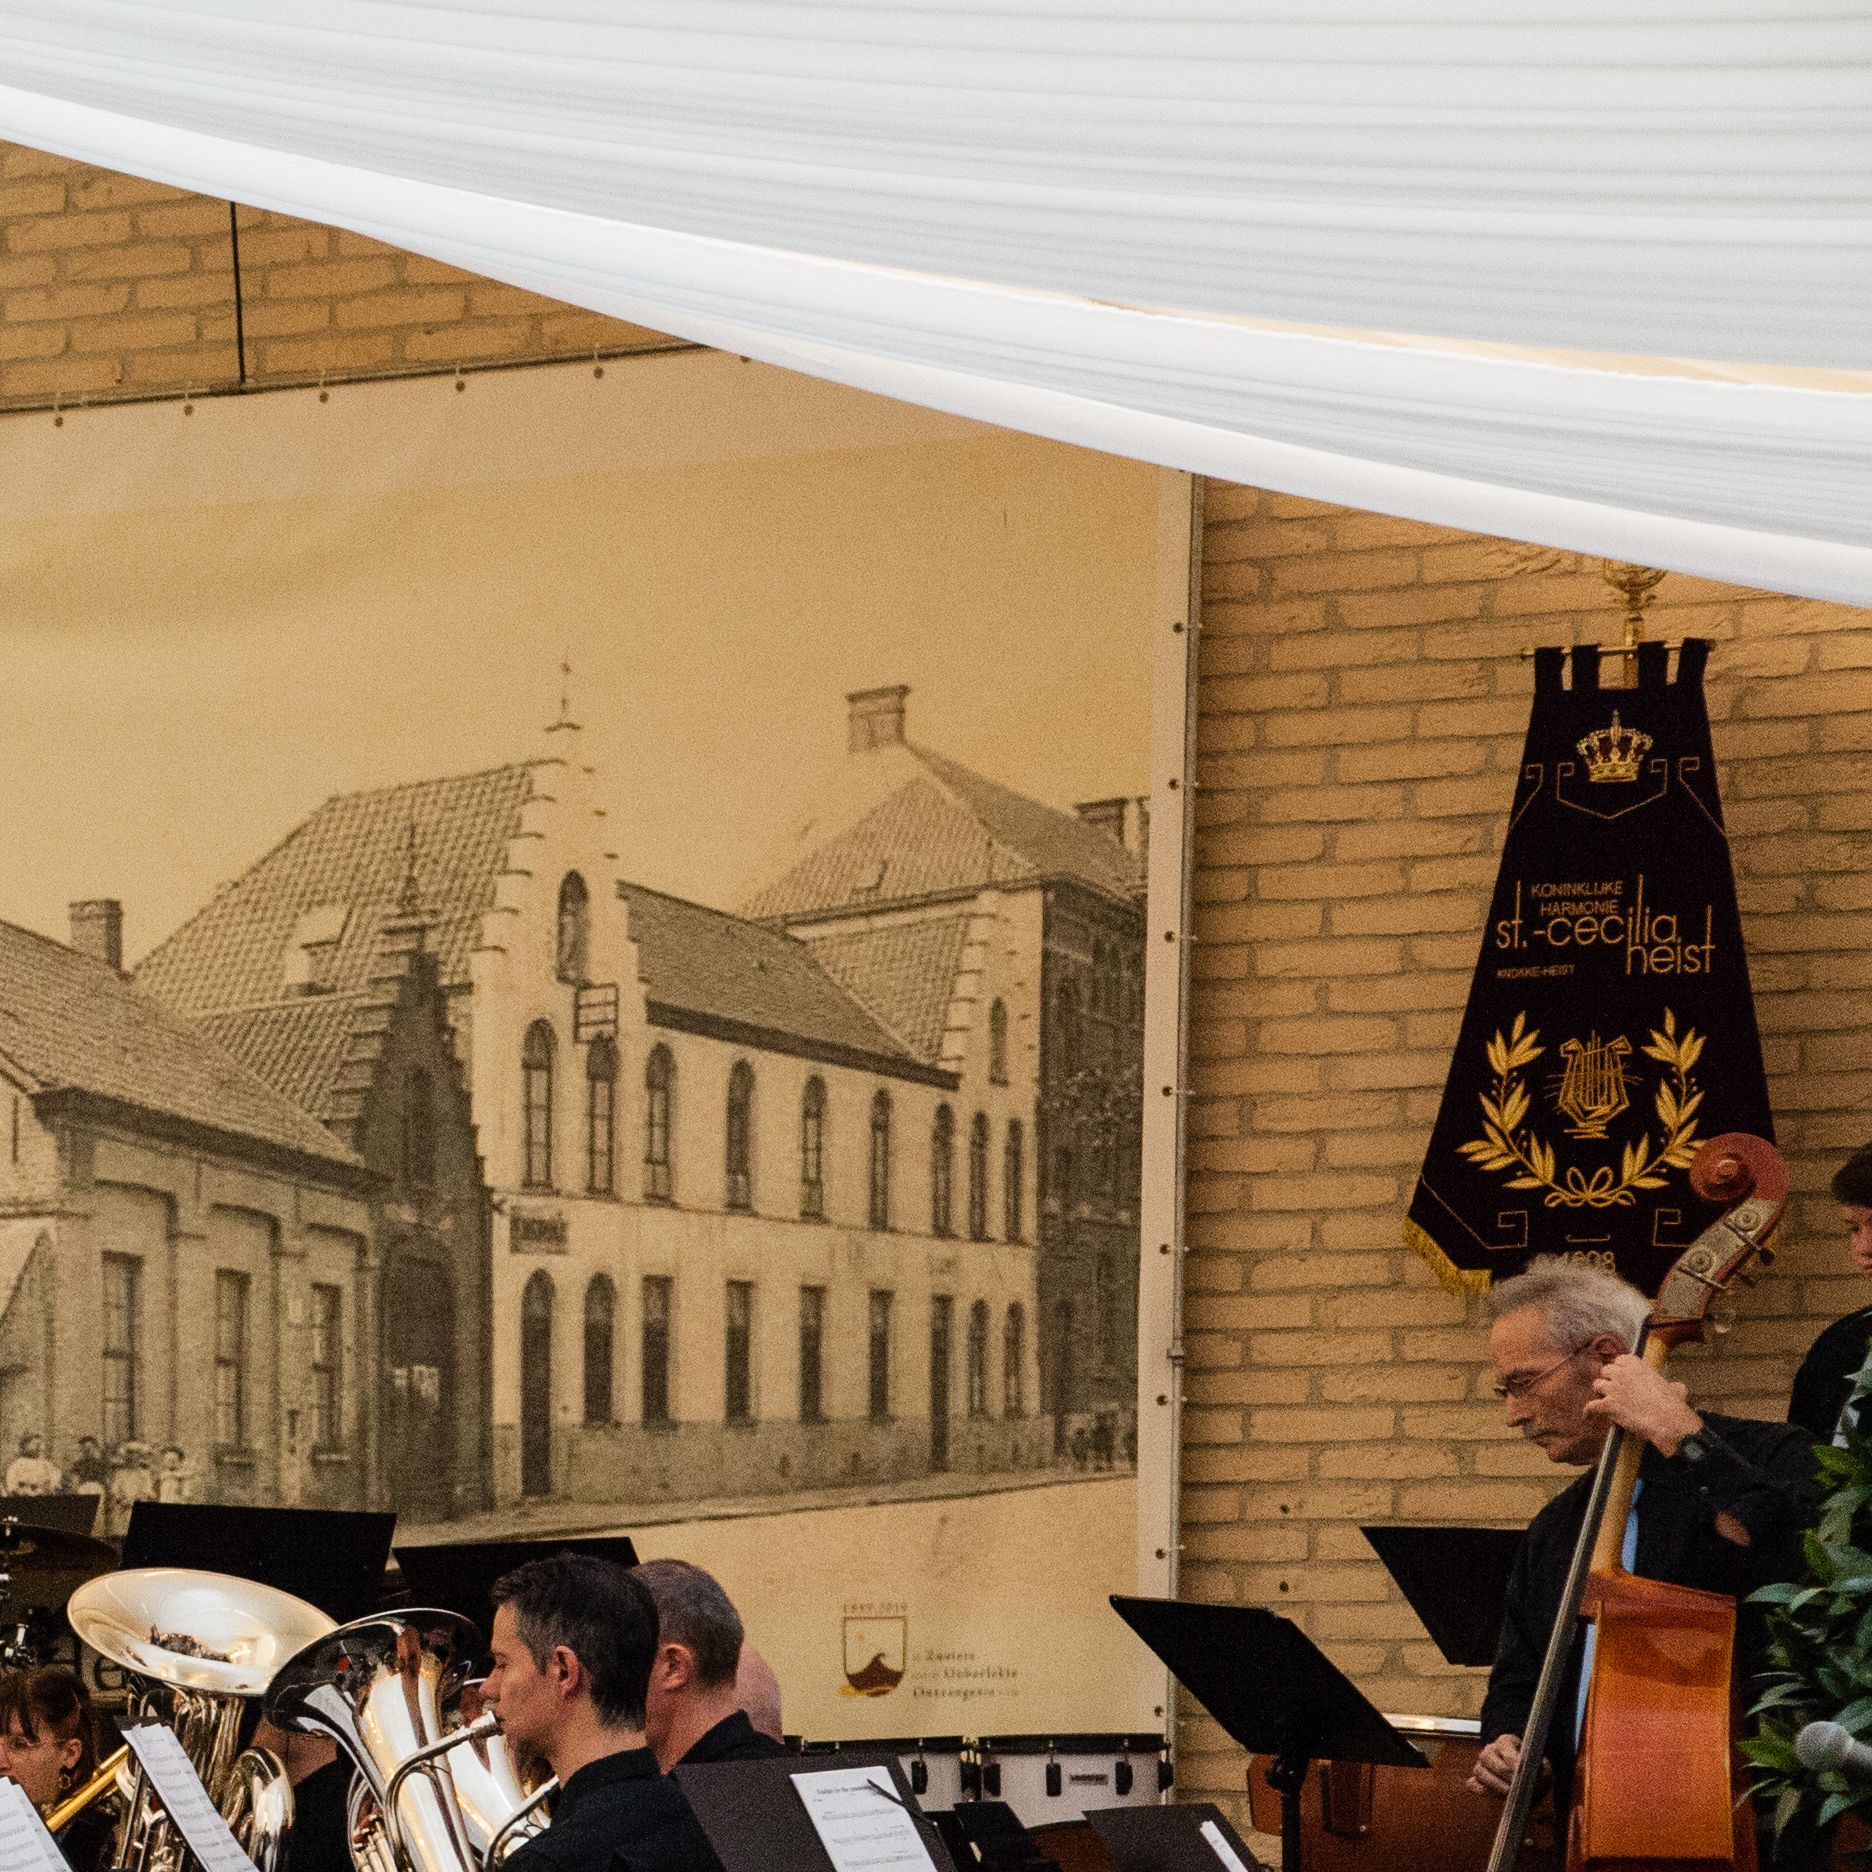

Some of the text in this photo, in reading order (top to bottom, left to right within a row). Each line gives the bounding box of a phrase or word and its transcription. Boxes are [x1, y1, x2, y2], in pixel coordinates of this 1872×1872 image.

[1531, 880, 1624, 898] KONINKLIJKE
[1539, 898, 1621, 917] HARMONIE
[1626, 904, 1717, 976] heist
